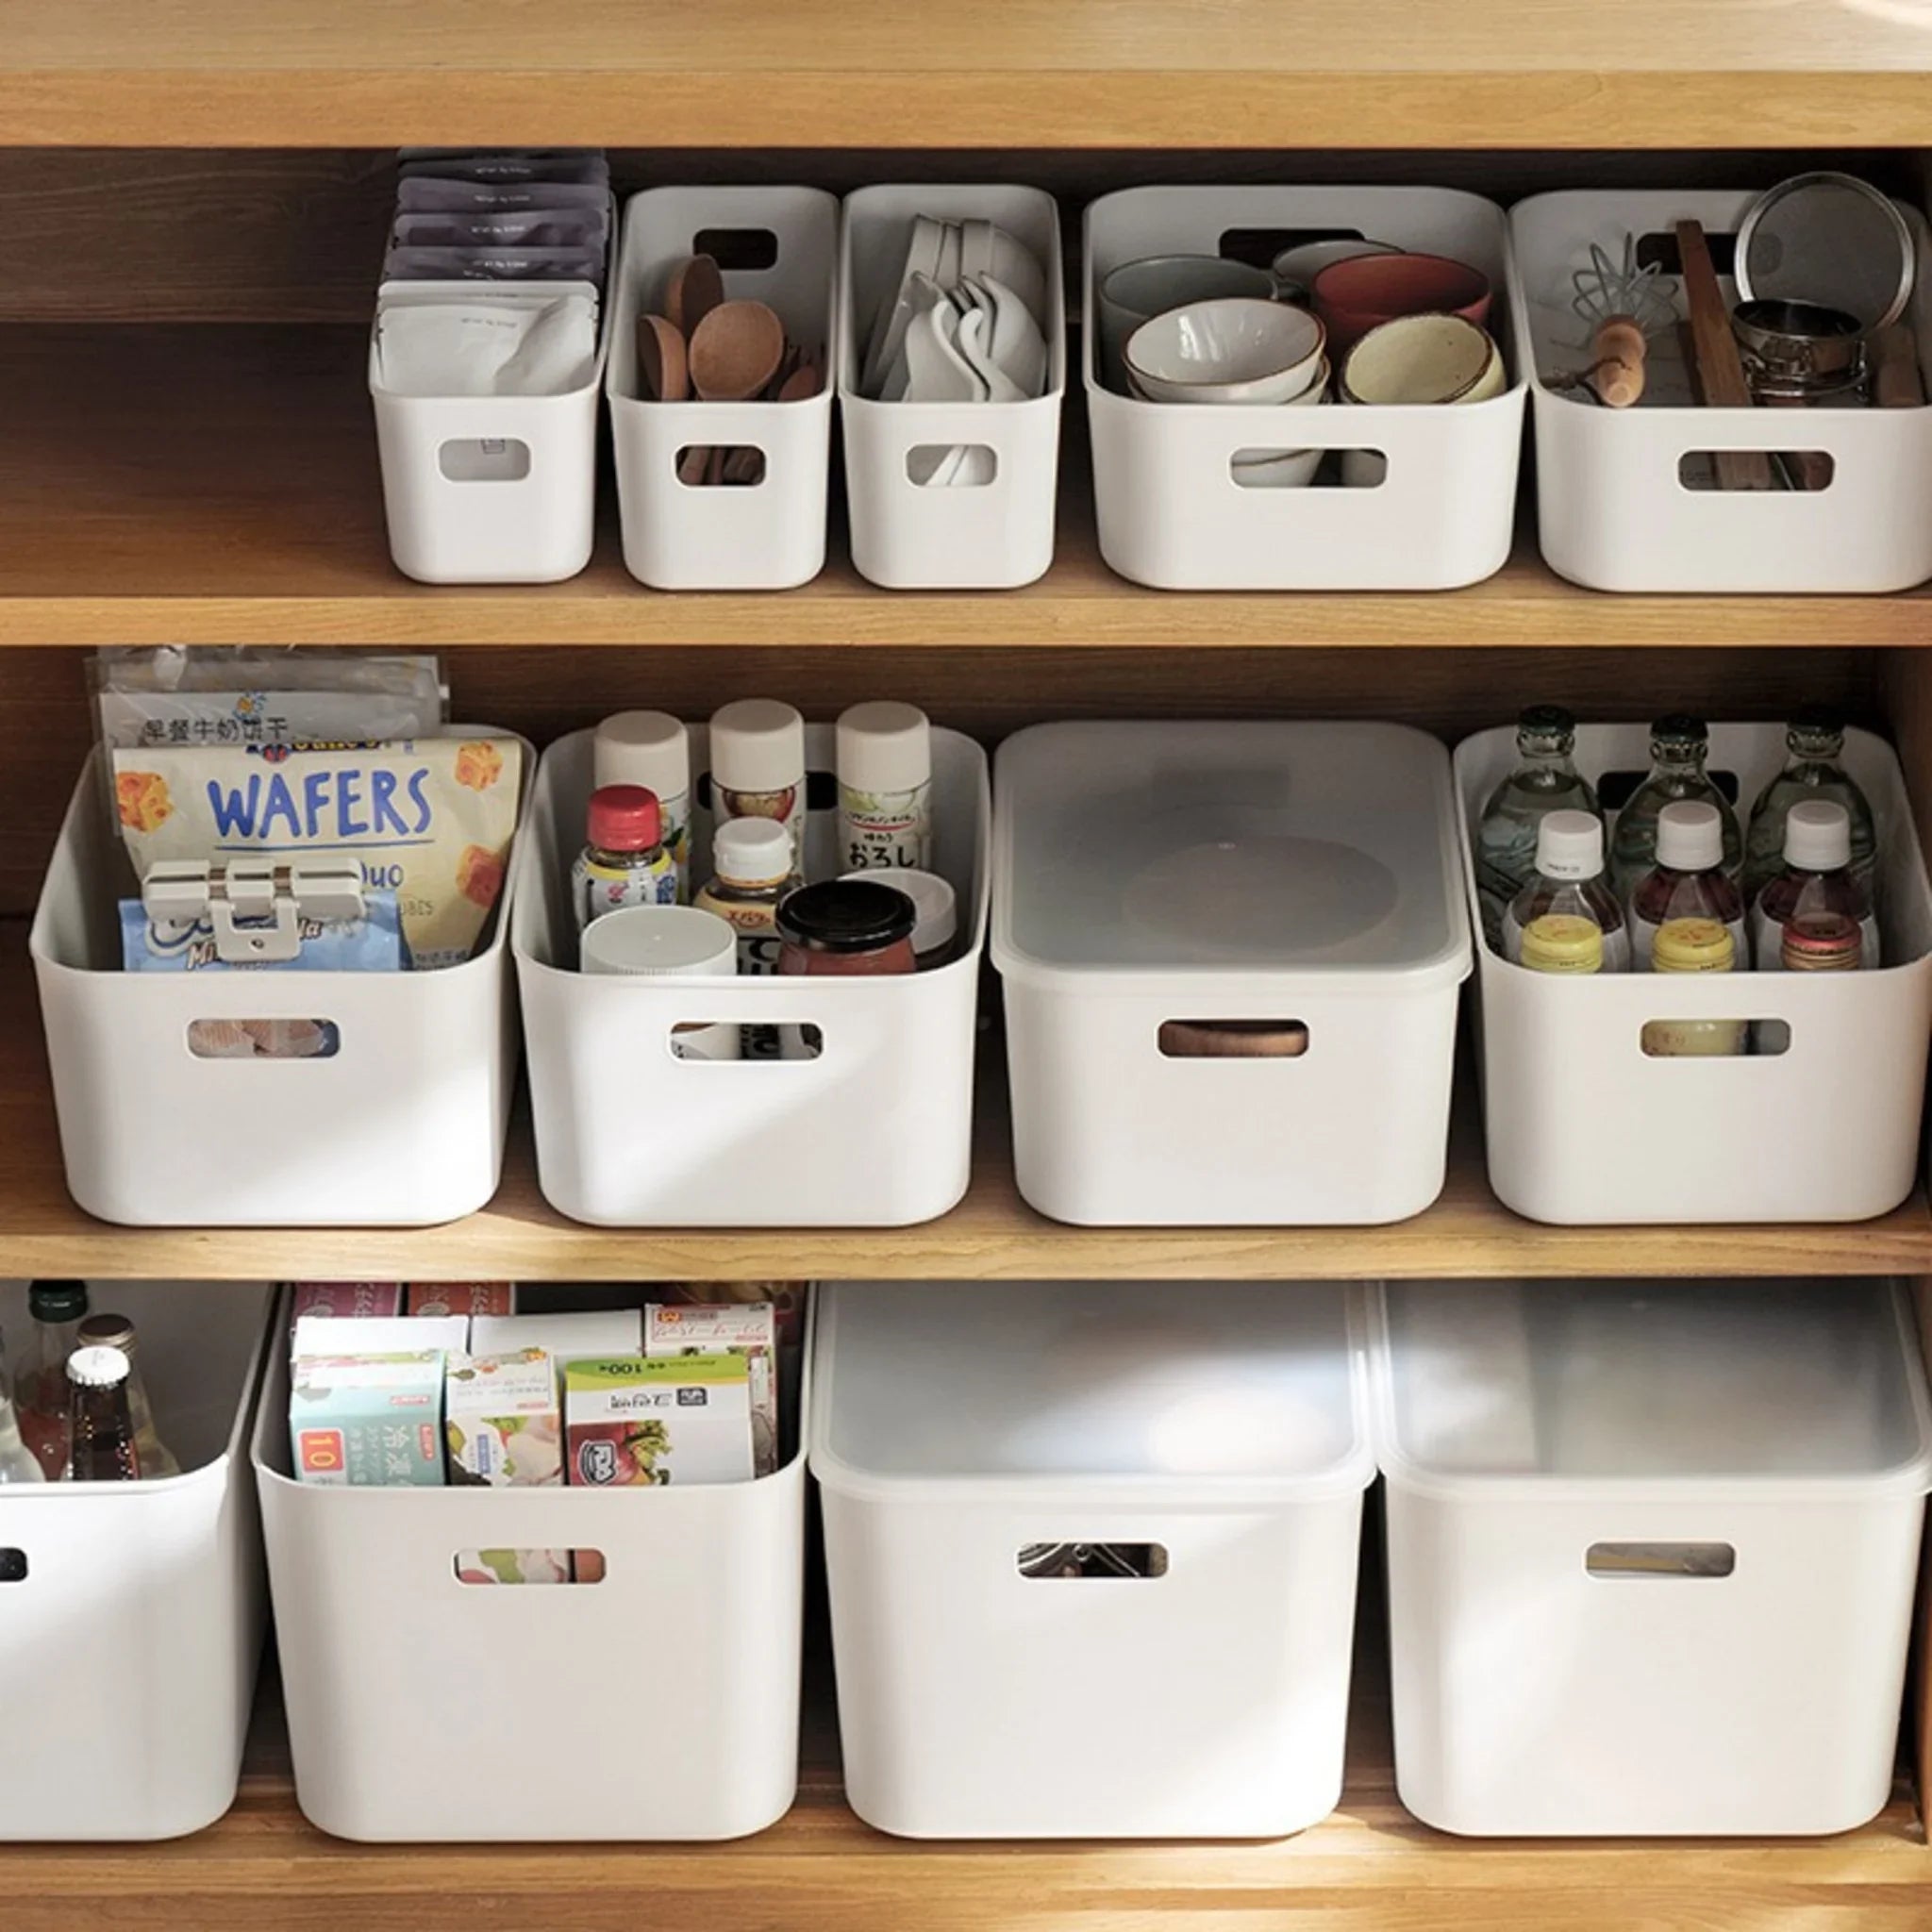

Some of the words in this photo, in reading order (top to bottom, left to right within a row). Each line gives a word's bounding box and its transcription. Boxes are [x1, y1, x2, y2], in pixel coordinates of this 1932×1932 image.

[207, 768, 431, 839] WAFERS
[850, 842, 915, 868] おろし
[308, 1436, 337, 1467] 10
